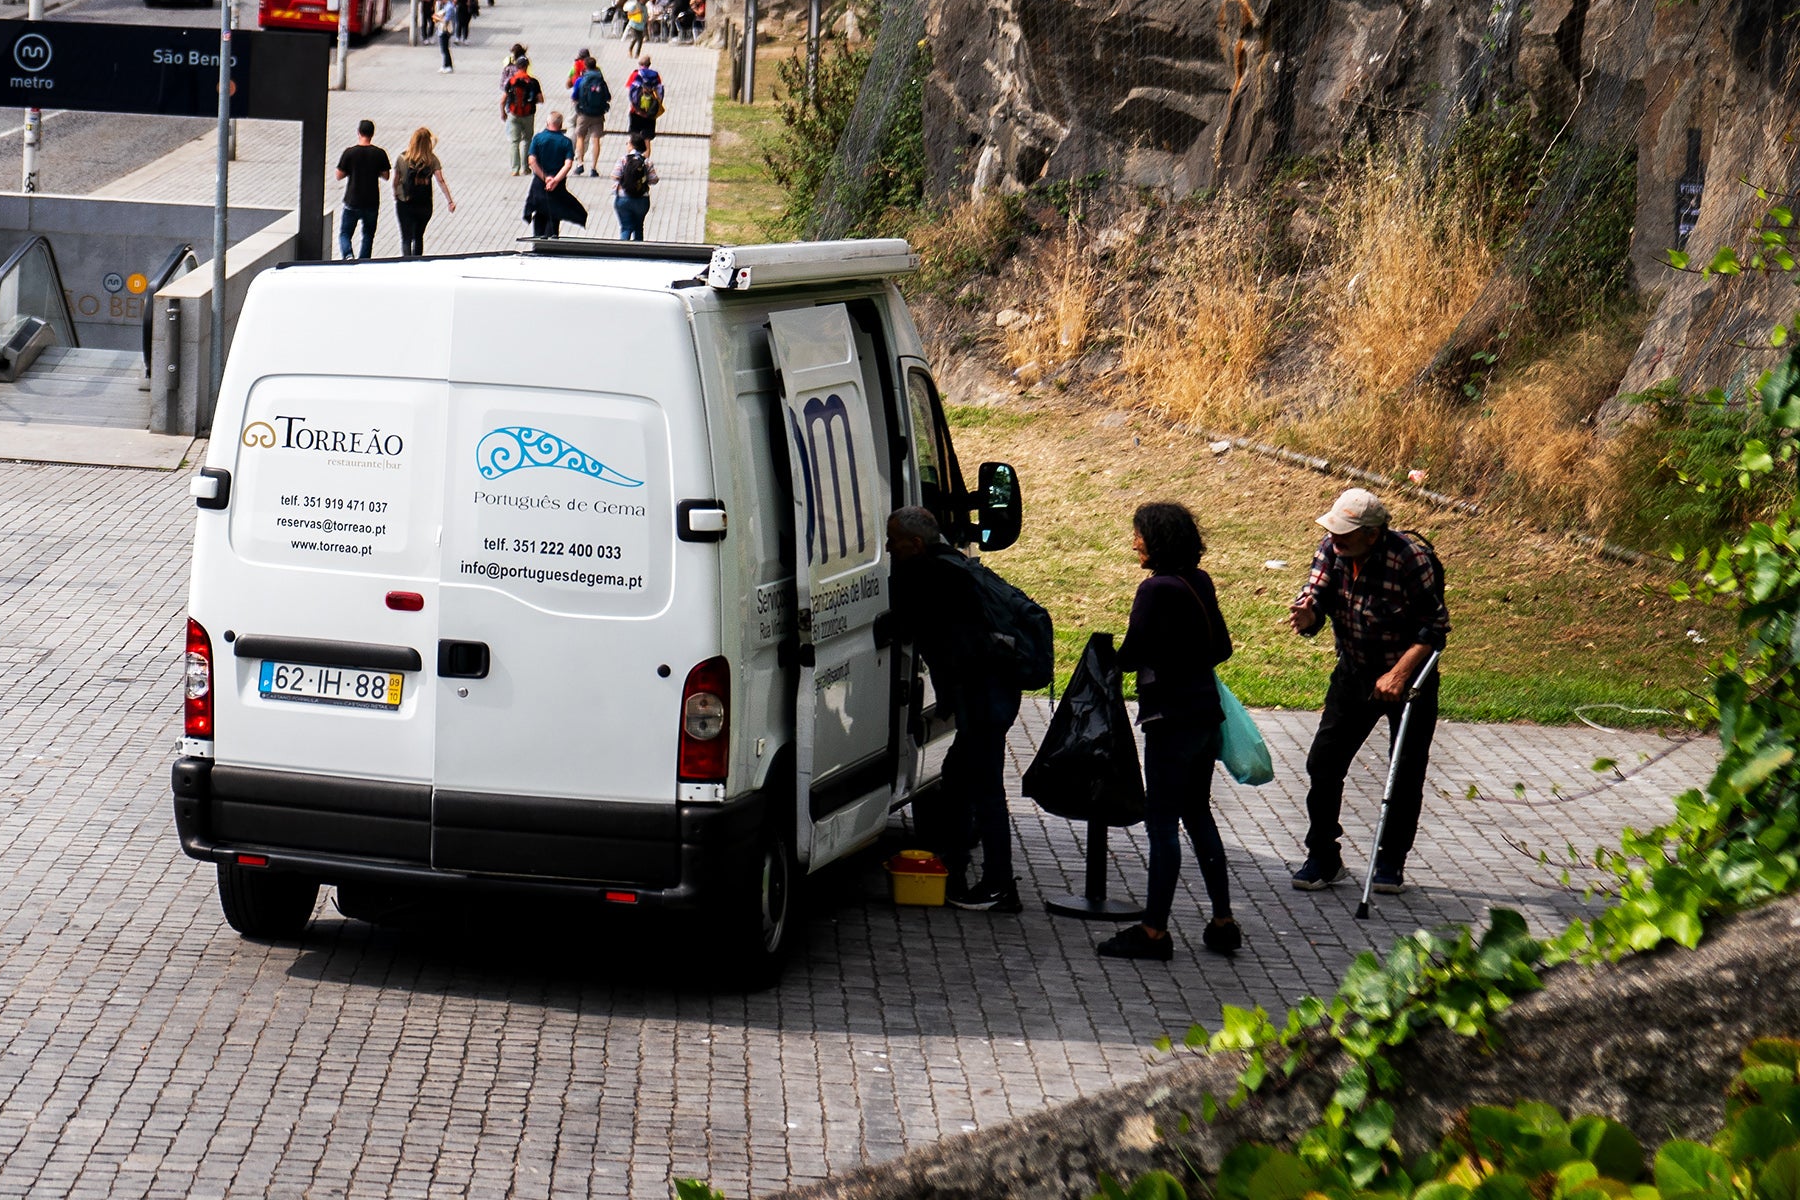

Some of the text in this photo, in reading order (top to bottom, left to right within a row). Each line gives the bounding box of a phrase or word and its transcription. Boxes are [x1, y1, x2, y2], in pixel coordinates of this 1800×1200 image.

[152, 48, 238, 68] São Beno
[10, 75, 54, 90] metro
[275, 415, 404, 456] TORREÃO
[281, 494, 388, 513] telf. 351 919 471 037
[474, 491, 646, 517] Português de Gema
[276, 516, 386, 537] reservas@torreao.pt
[291, 539, 373, 557] www.torreao.pt
[484, 537, 622, 560] telf. 351 222 400 033
[460, 560, 643, 590] info@portuguesdegema.pt
[389, 678, 400, 687] 09
[390, 692, 398, 701] 10
